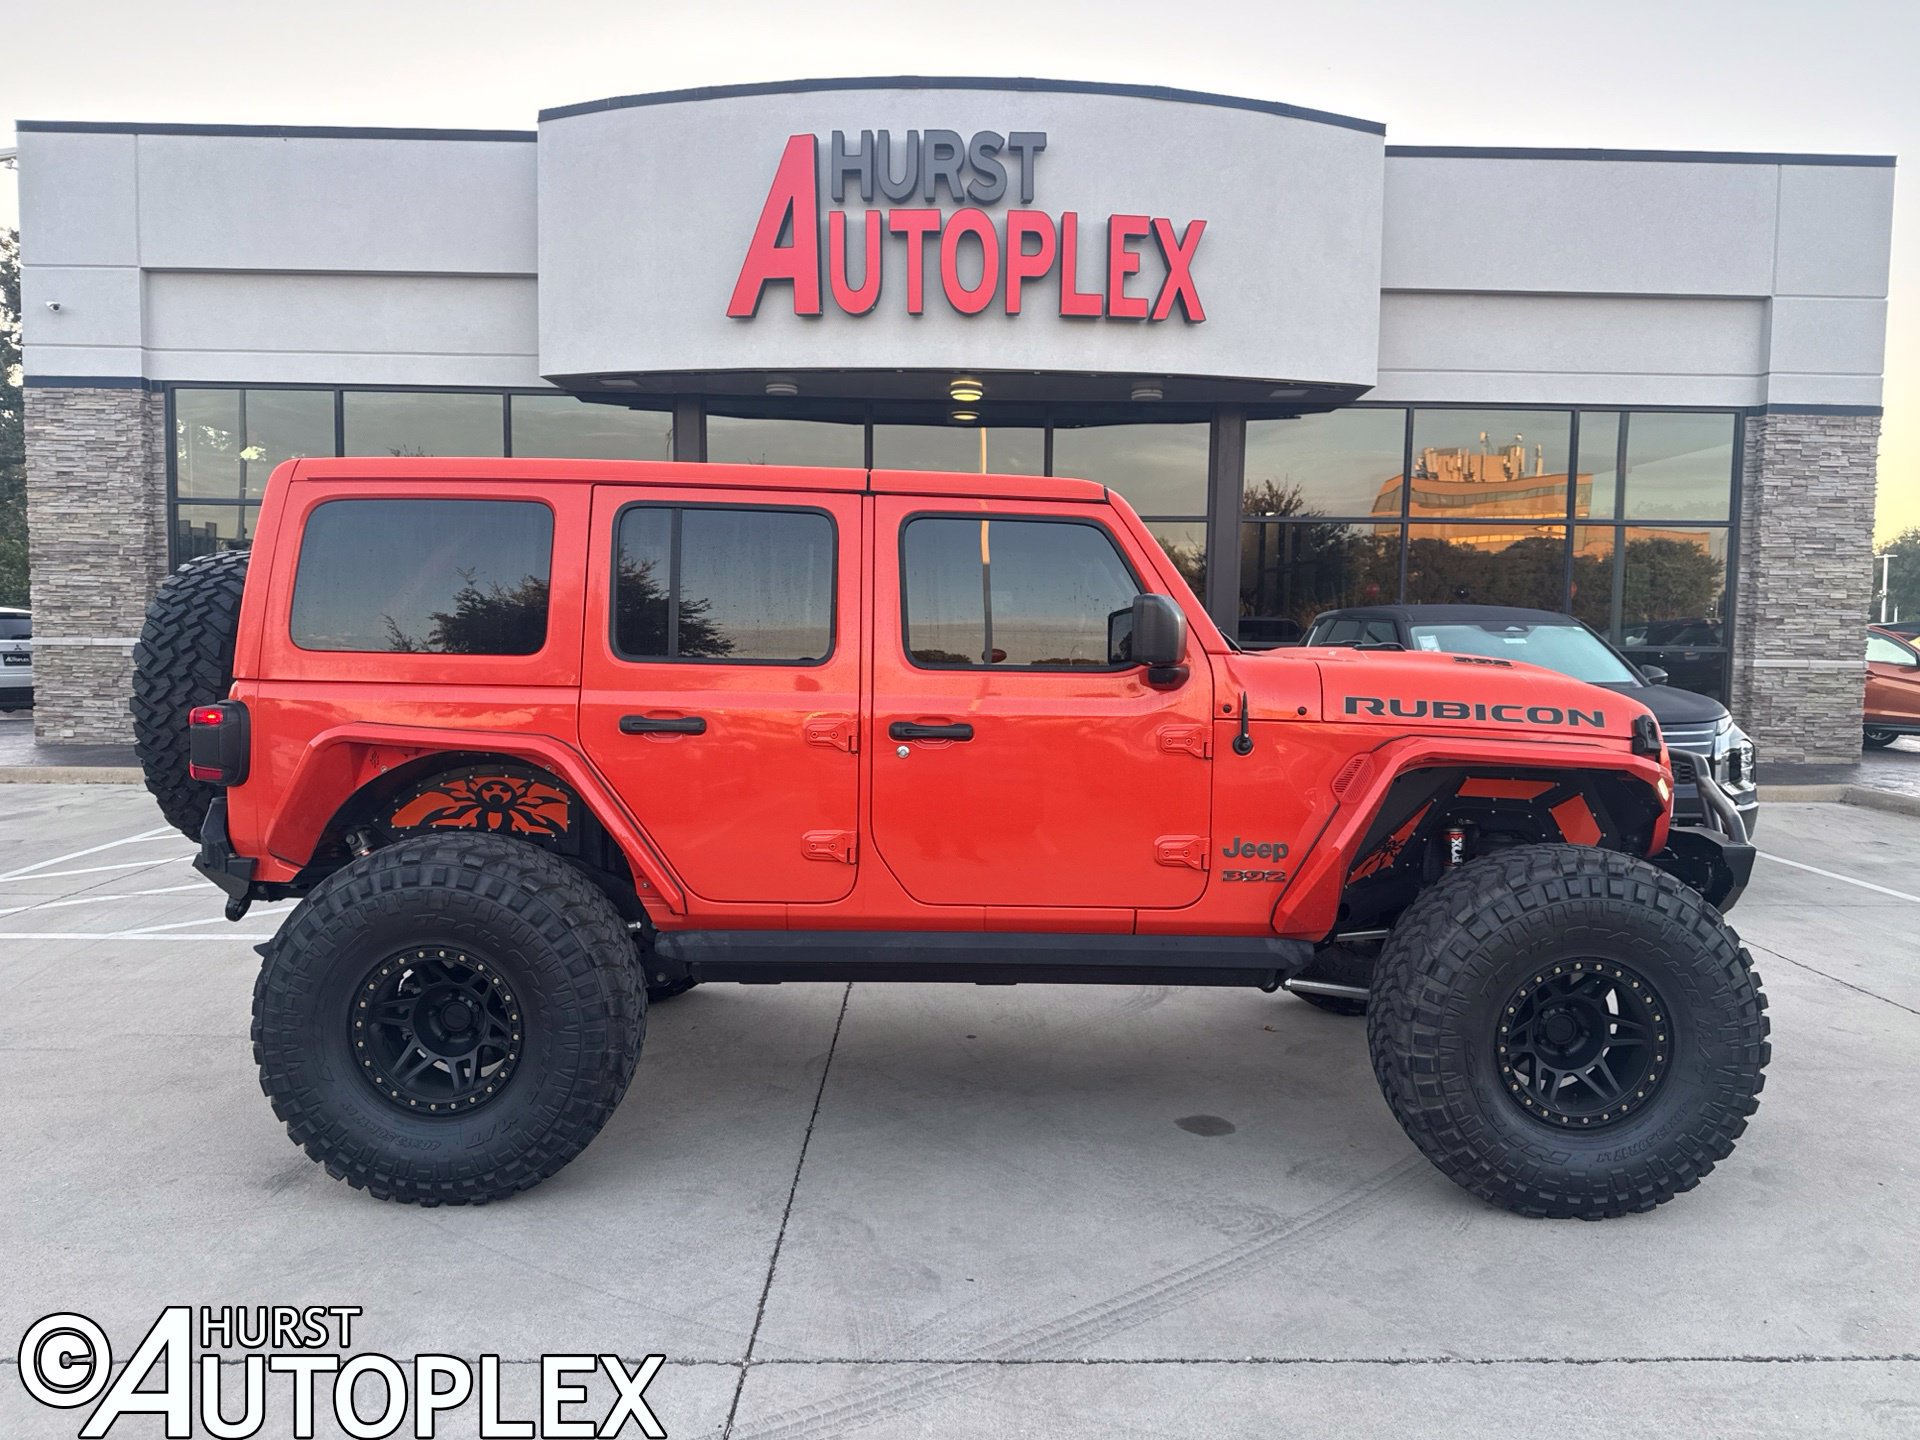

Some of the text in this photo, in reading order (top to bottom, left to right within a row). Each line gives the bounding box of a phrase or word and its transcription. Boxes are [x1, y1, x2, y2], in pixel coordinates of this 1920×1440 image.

[831, 130, 1047, 204] HURST
[726, 133, 1207, 324] AUTOPLEX
[1344, 696, 1606, 729] RUBICON
[1222, 835, 1289, 863] Jeep
[1451, 837, 1463, 864] FOX
